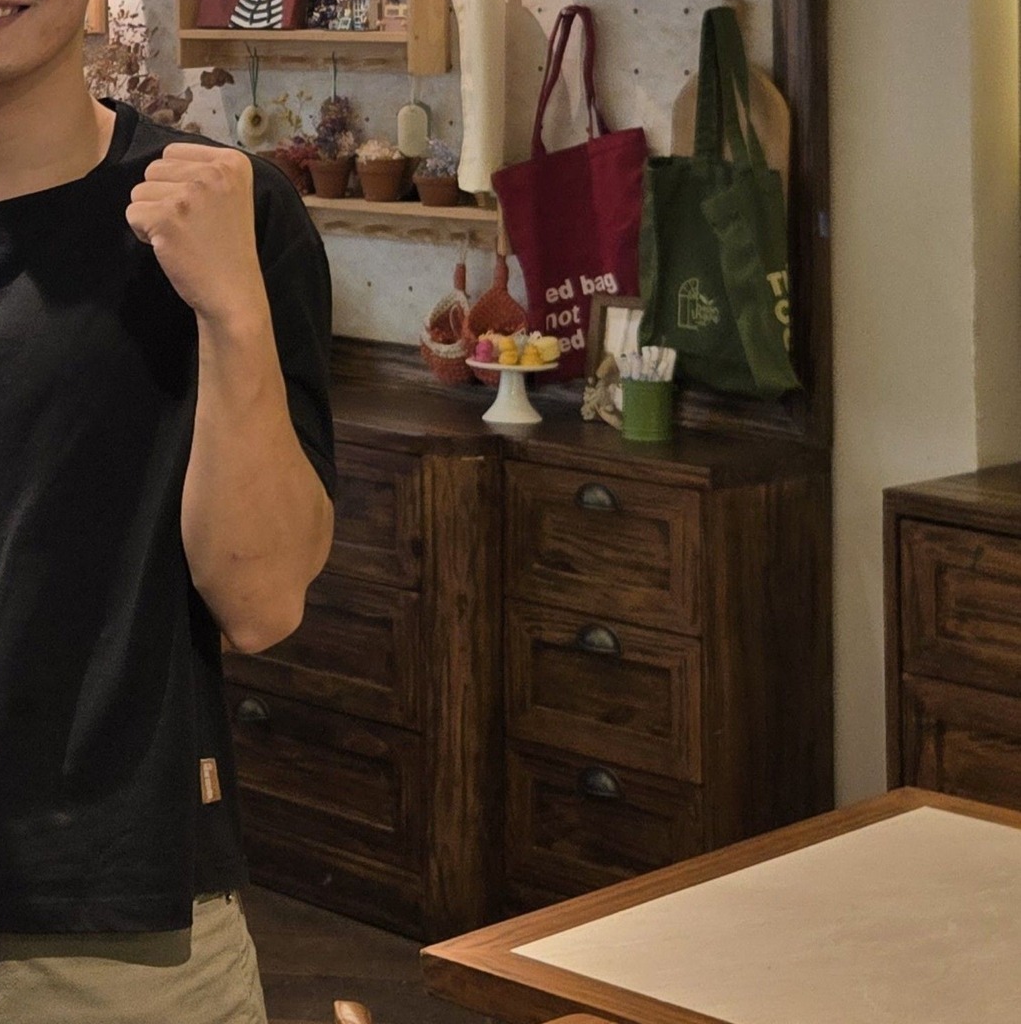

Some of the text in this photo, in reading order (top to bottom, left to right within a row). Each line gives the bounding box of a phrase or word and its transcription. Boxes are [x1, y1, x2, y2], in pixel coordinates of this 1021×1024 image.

[545, 272, 618, 303] ed bag
[545, 305, 580, 331] not
[558, 328, 585, 353] ed
